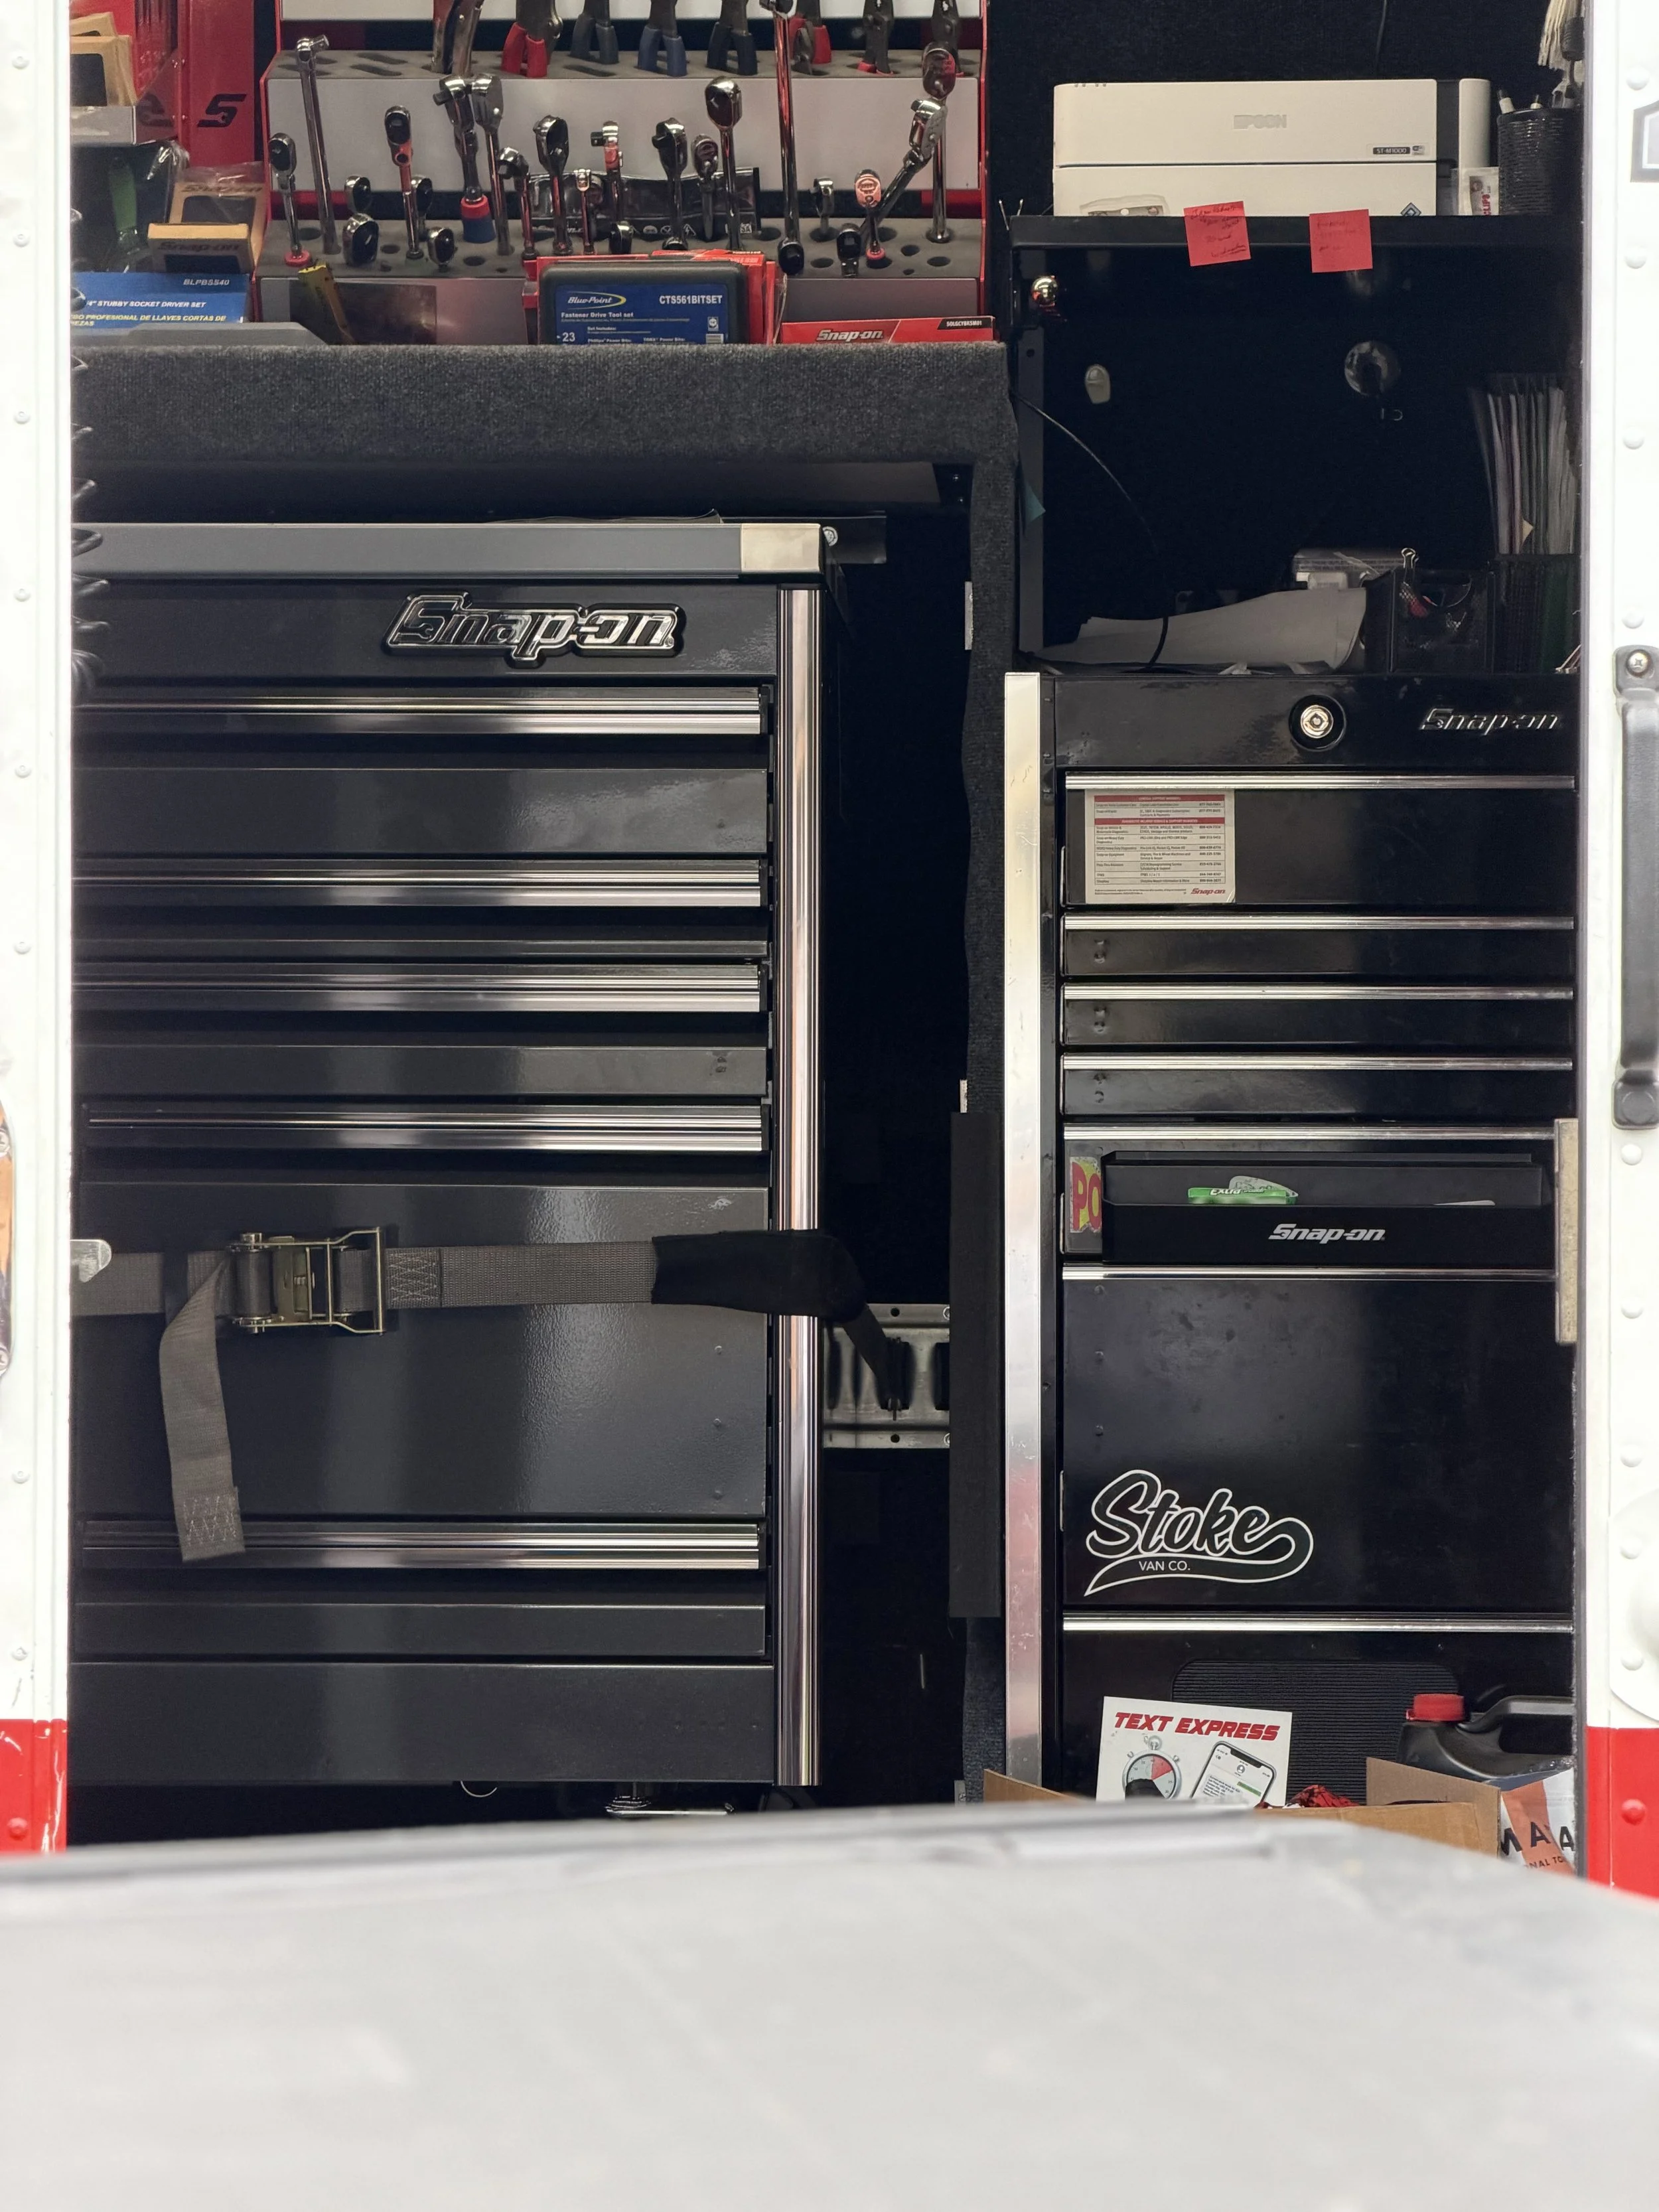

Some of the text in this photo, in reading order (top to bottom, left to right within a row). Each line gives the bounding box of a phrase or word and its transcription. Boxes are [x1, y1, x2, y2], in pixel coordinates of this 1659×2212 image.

[1234, 114, 1287, 129] EPSON
[659, 295, 723, 305] CTS561BITSET
[562, 332, 575, 342] 23
[816, 329, 883, 342] Snap-on
[389, 595, 676, 660] Snap-on
[1419, 707, 1559, 736] Snap-on
[1268, 1223, 1385, 1244] Snap-on
[1086, 1469, 1287, 1559] Stoke
[1139, 1561, 1190, 1571] VAN CO.
[1115, 1712, 1281, 1741] TEXT EXPRESS
